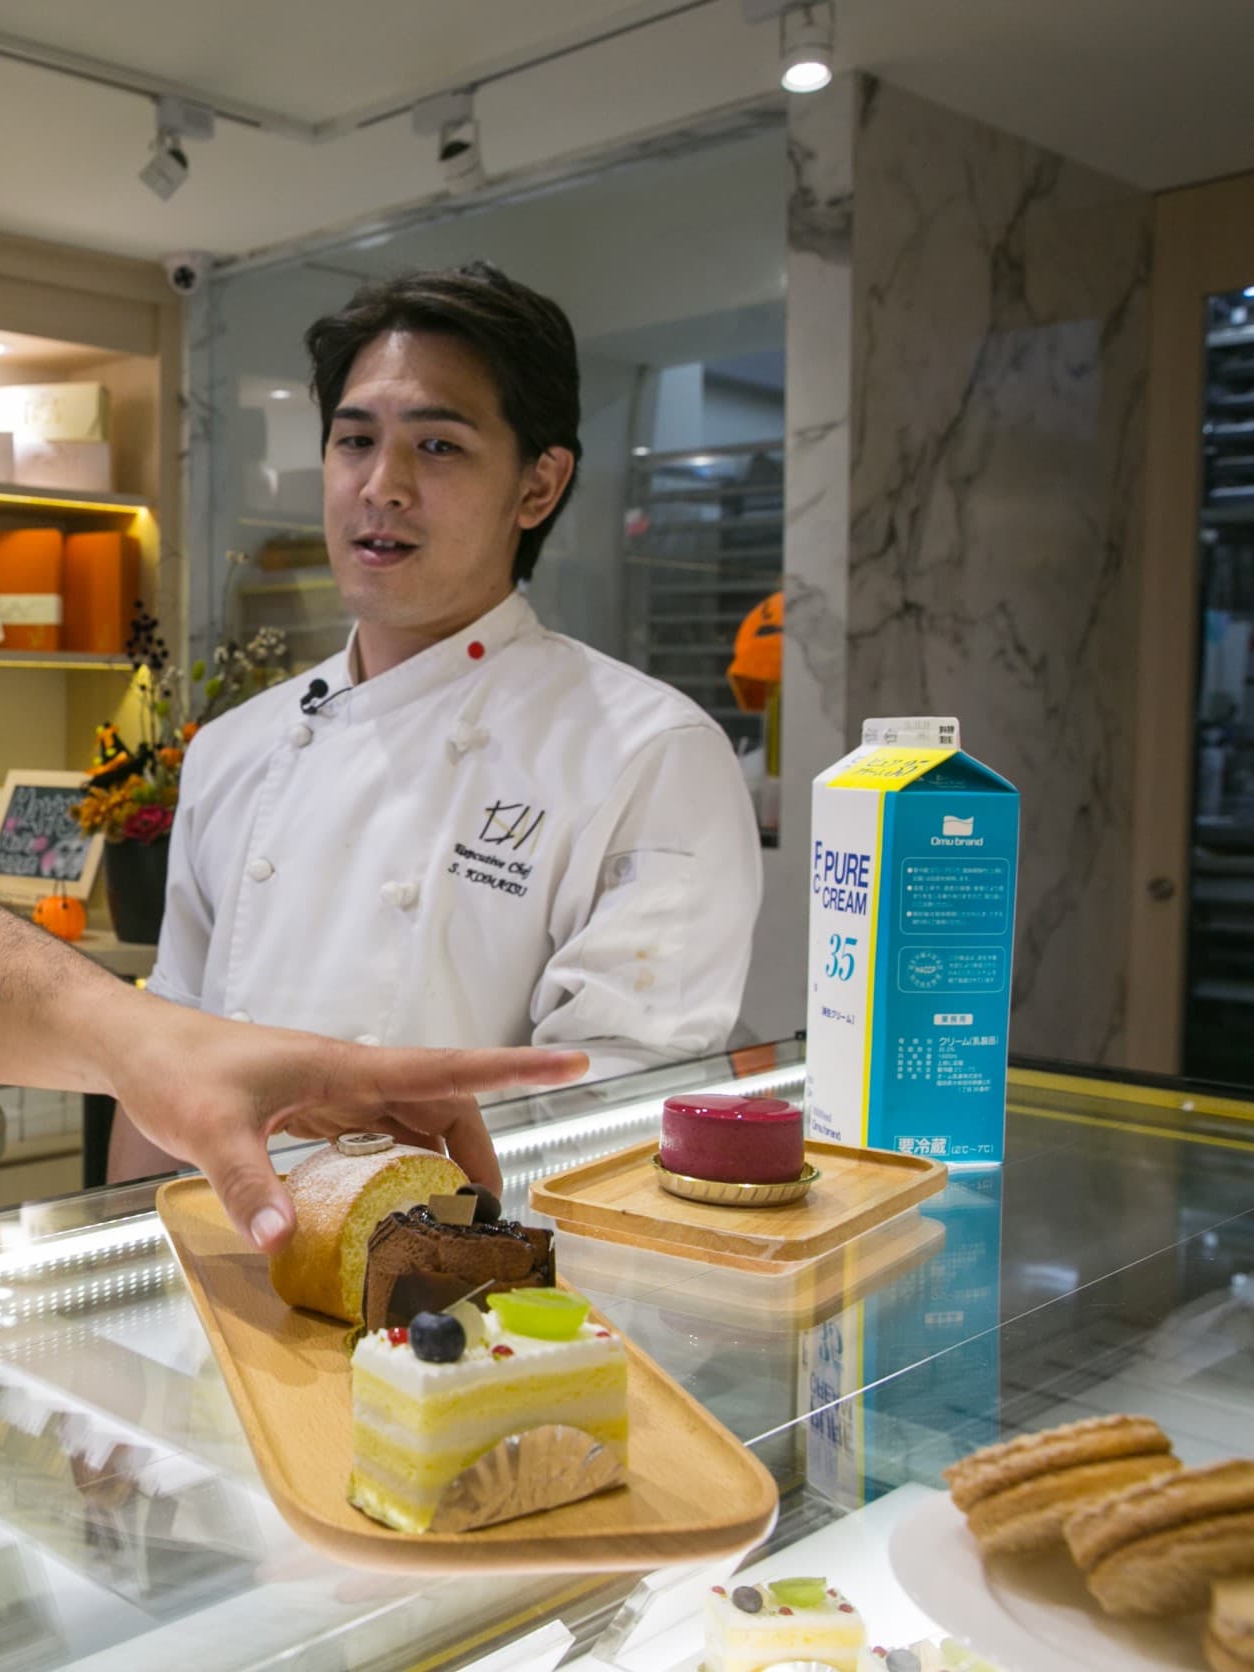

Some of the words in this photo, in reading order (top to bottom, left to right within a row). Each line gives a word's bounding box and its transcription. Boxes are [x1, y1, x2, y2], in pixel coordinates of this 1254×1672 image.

[824, 850, 870, 888] PURE
[822, 886, 867, 916] CREAM
[825, 933, 858, 982] 35
[898, 1138, 946, 1155] 要冷蔵
